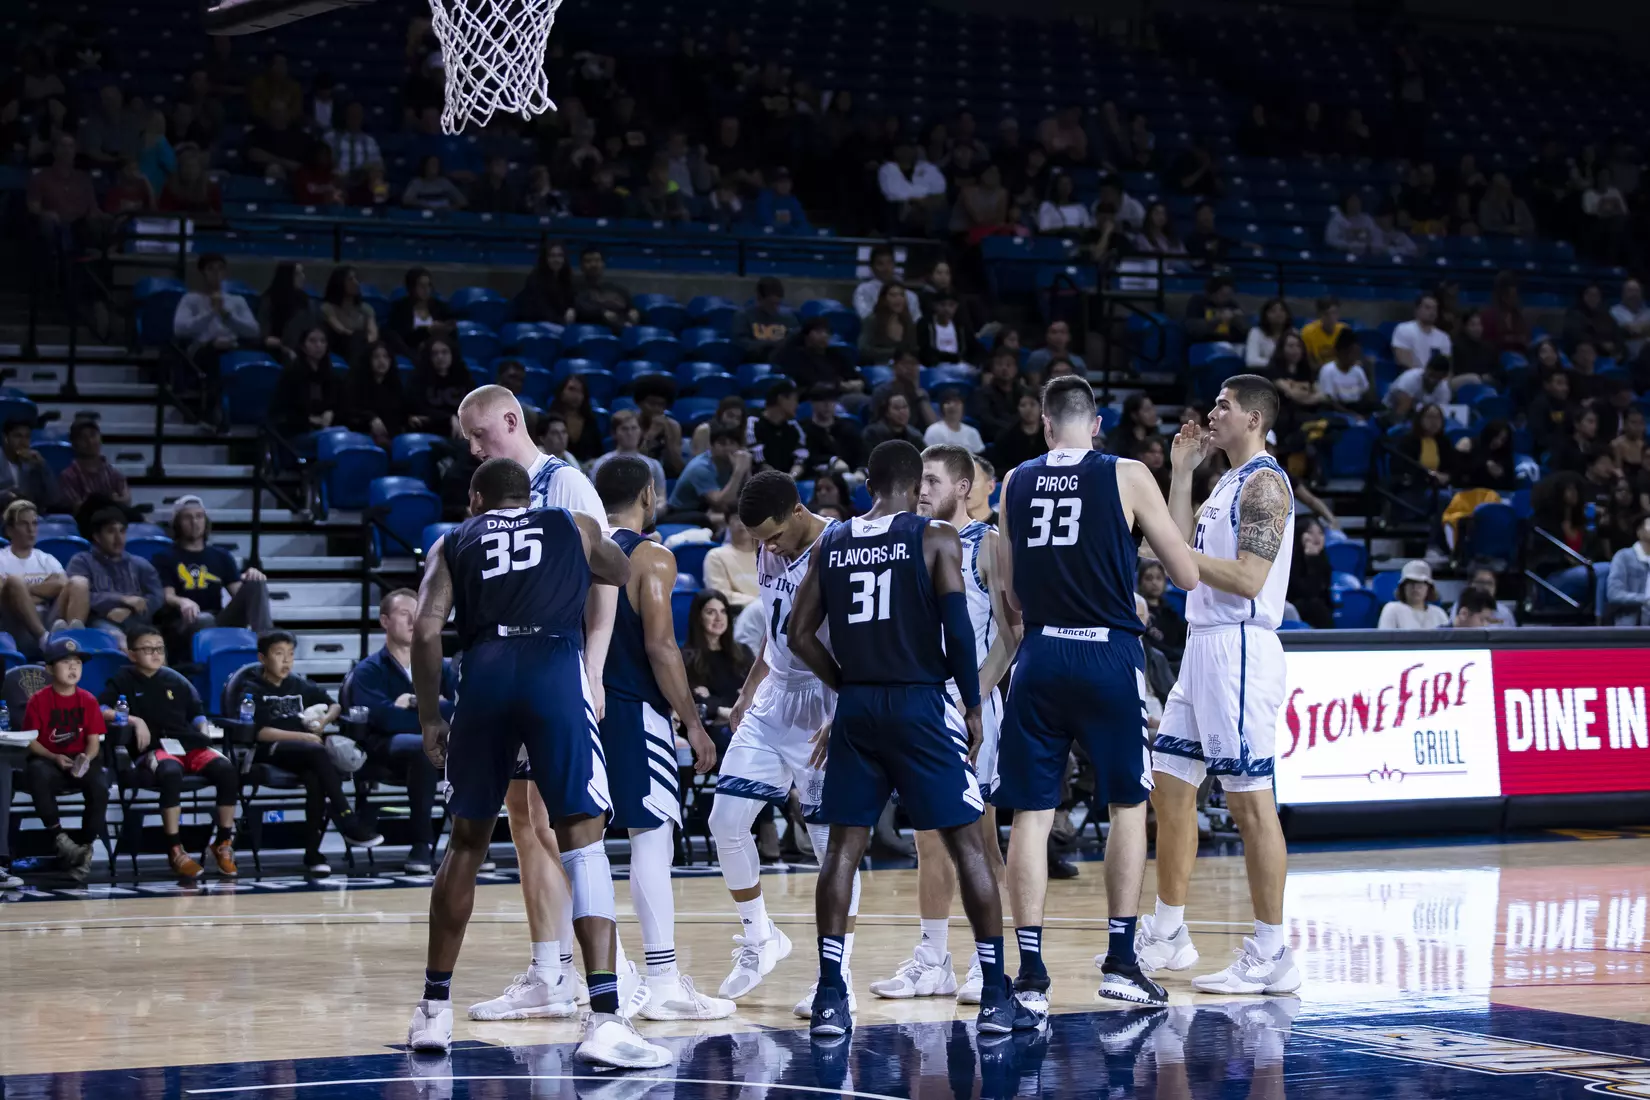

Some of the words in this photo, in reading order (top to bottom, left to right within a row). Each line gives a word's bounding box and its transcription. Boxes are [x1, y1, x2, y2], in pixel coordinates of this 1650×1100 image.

[1035, 475, 1079, 492] PIROG
[486, 517, 530, 530] DAVIS
[1027, 497, 1082, 548] 33
[480, 527, 544, 580] 35
[828, 545, 889, 568] FLAVORS
[889, 543, 911, 561] JR.
[758, 572, 773, 588] UC
[848, 568, 892, 624] 31
[1057, 627, 1097, 639] LanceUp
[1504, 687, 1602, 752] DINE
[1605, 686, 1650, 750] IN
[1414, 729, 1466, 765] GRILL
